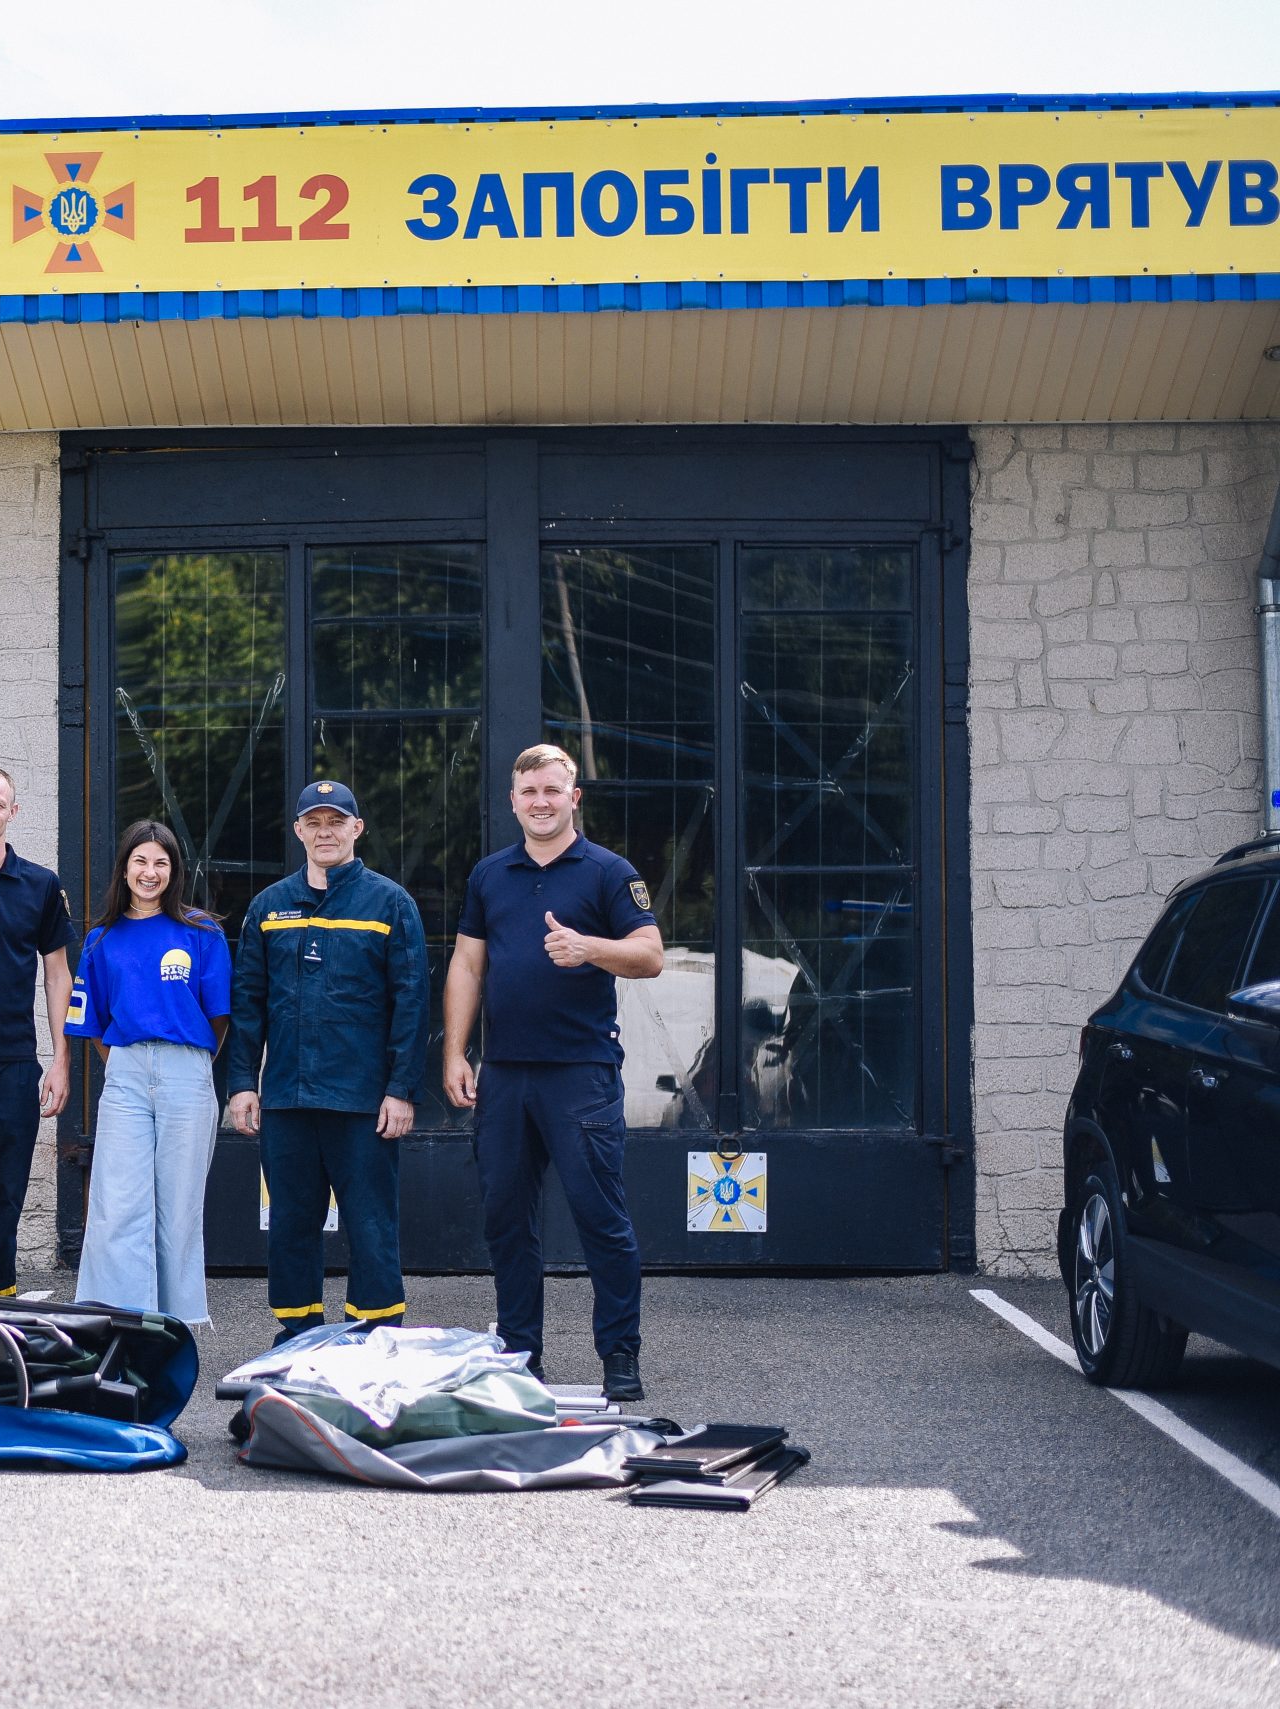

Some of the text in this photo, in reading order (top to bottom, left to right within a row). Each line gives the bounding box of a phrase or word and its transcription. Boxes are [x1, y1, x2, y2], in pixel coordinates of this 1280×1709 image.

[184, 174, 351, 243] 112
[404, 152, 881, 241] ЗАПОБІГТИ
[940, 159, 1280, 231] ВРЯТУВ
[160, 965, 190, 978] RISE
